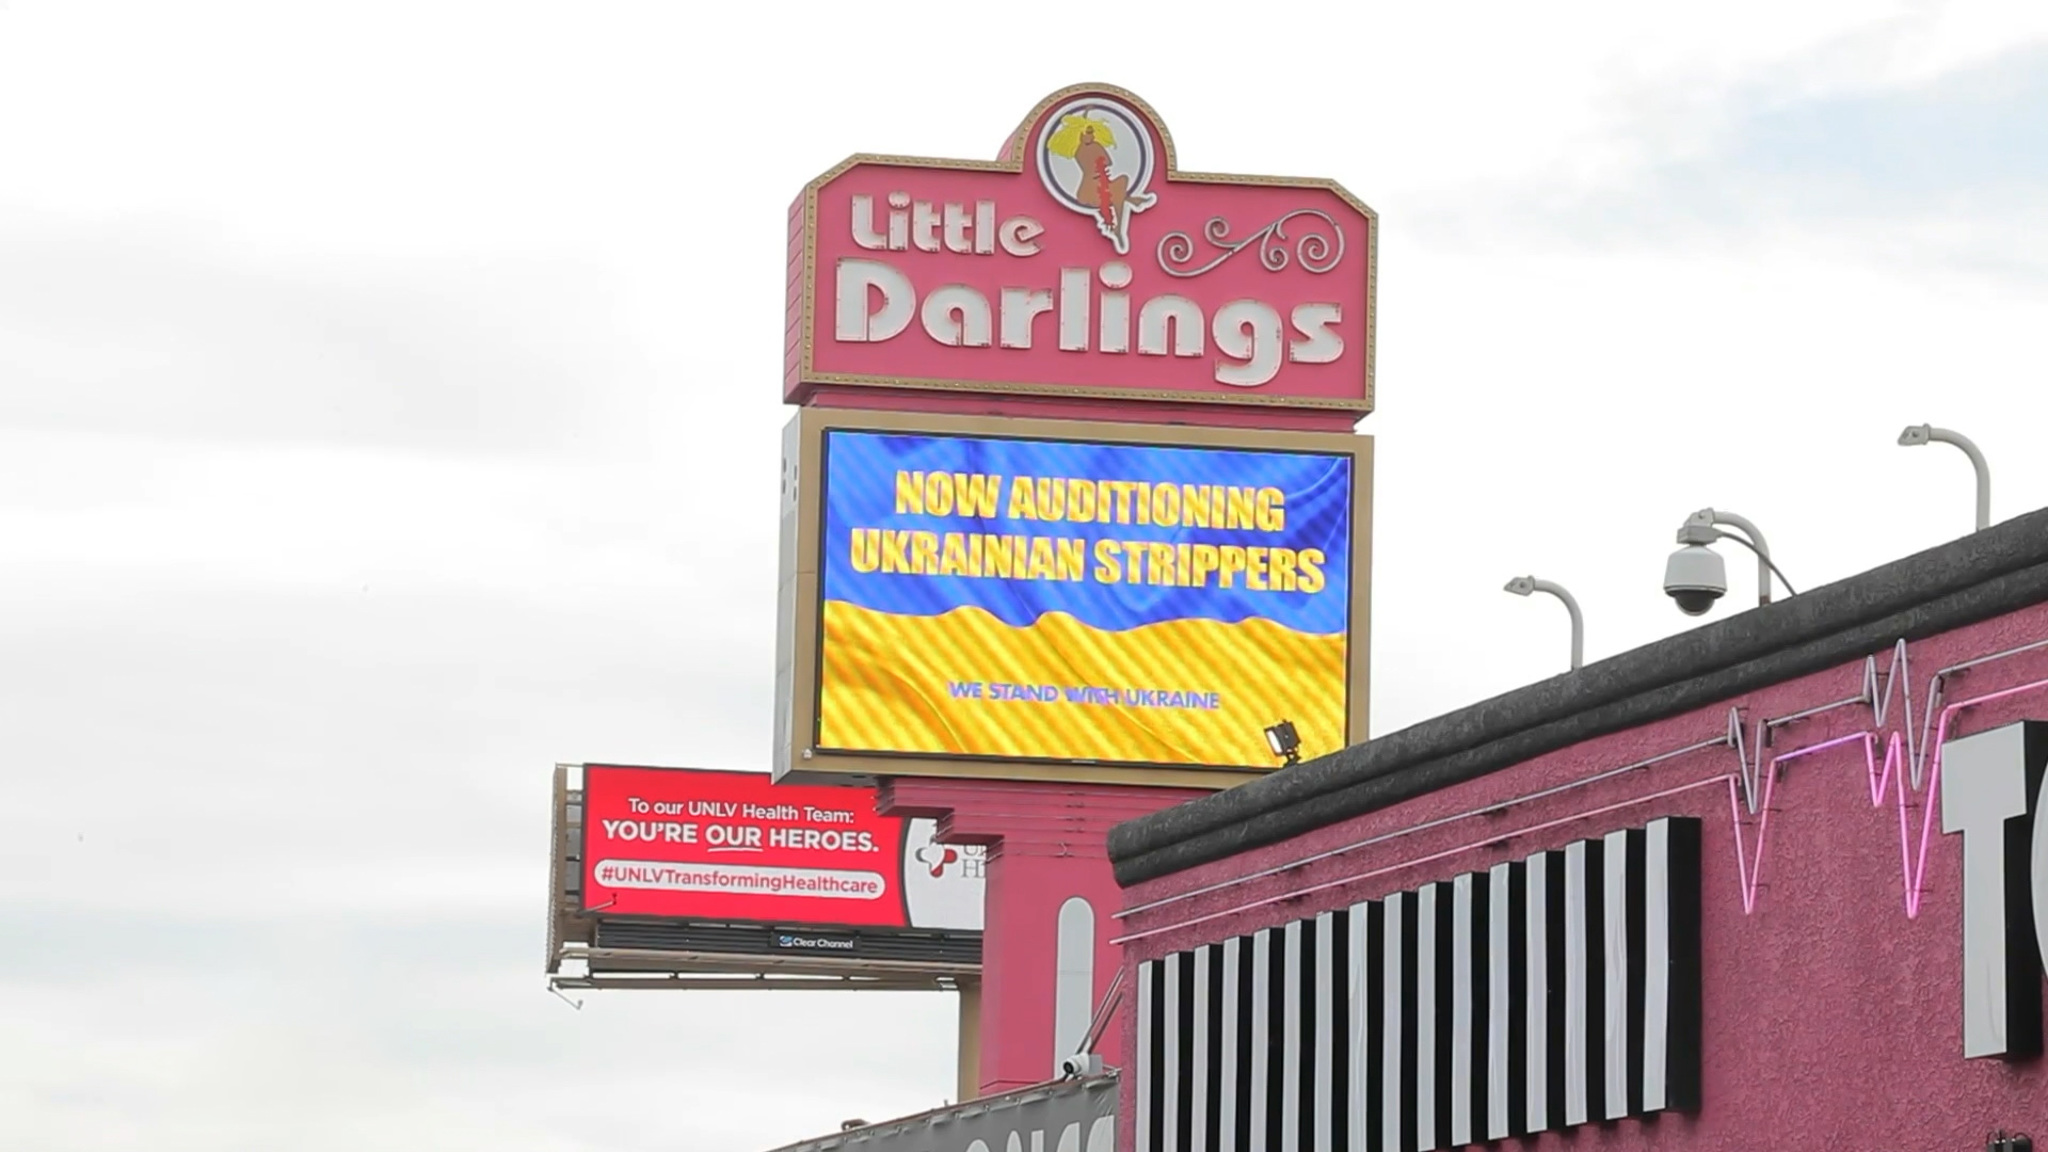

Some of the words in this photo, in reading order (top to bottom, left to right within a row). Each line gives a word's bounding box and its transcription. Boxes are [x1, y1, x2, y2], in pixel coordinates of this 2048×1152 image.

[850, 191, 1045, 257] Little
[834, 257, 1345, 387] Darlings
[895, 469, 1002, 518] NOW
[1008, 475, 1286, 533] AUDITIONING
[850, 528, 1086, 583] UKRAINIAN
[1093, 538, 1326, 594] STRIPPERS
[949, 681, 983, 699] WE
[988, 682, 1059, 702] STAND
[1064, 685, 1119, 705] WITH
[1124, 688, 1221, 710] UKRAINE
[628, 797, 650, 814] To
[653, 801, 685, 816] our
[688, 801, 738, 818] UNLV
[742, 803, 799, 821] Health
[803, 806, 855, 824] Team:
[602, 819, 699, 843] YOU'RE
[705, 824, 763, 847] OUR
[769, 828, 880, 853] HEROES.
[601, 865, 879, 894] #UNLVTransformingHealthcare
[793, 937, 817, 948] Clear
[817, 938, 854, 949] Channel
